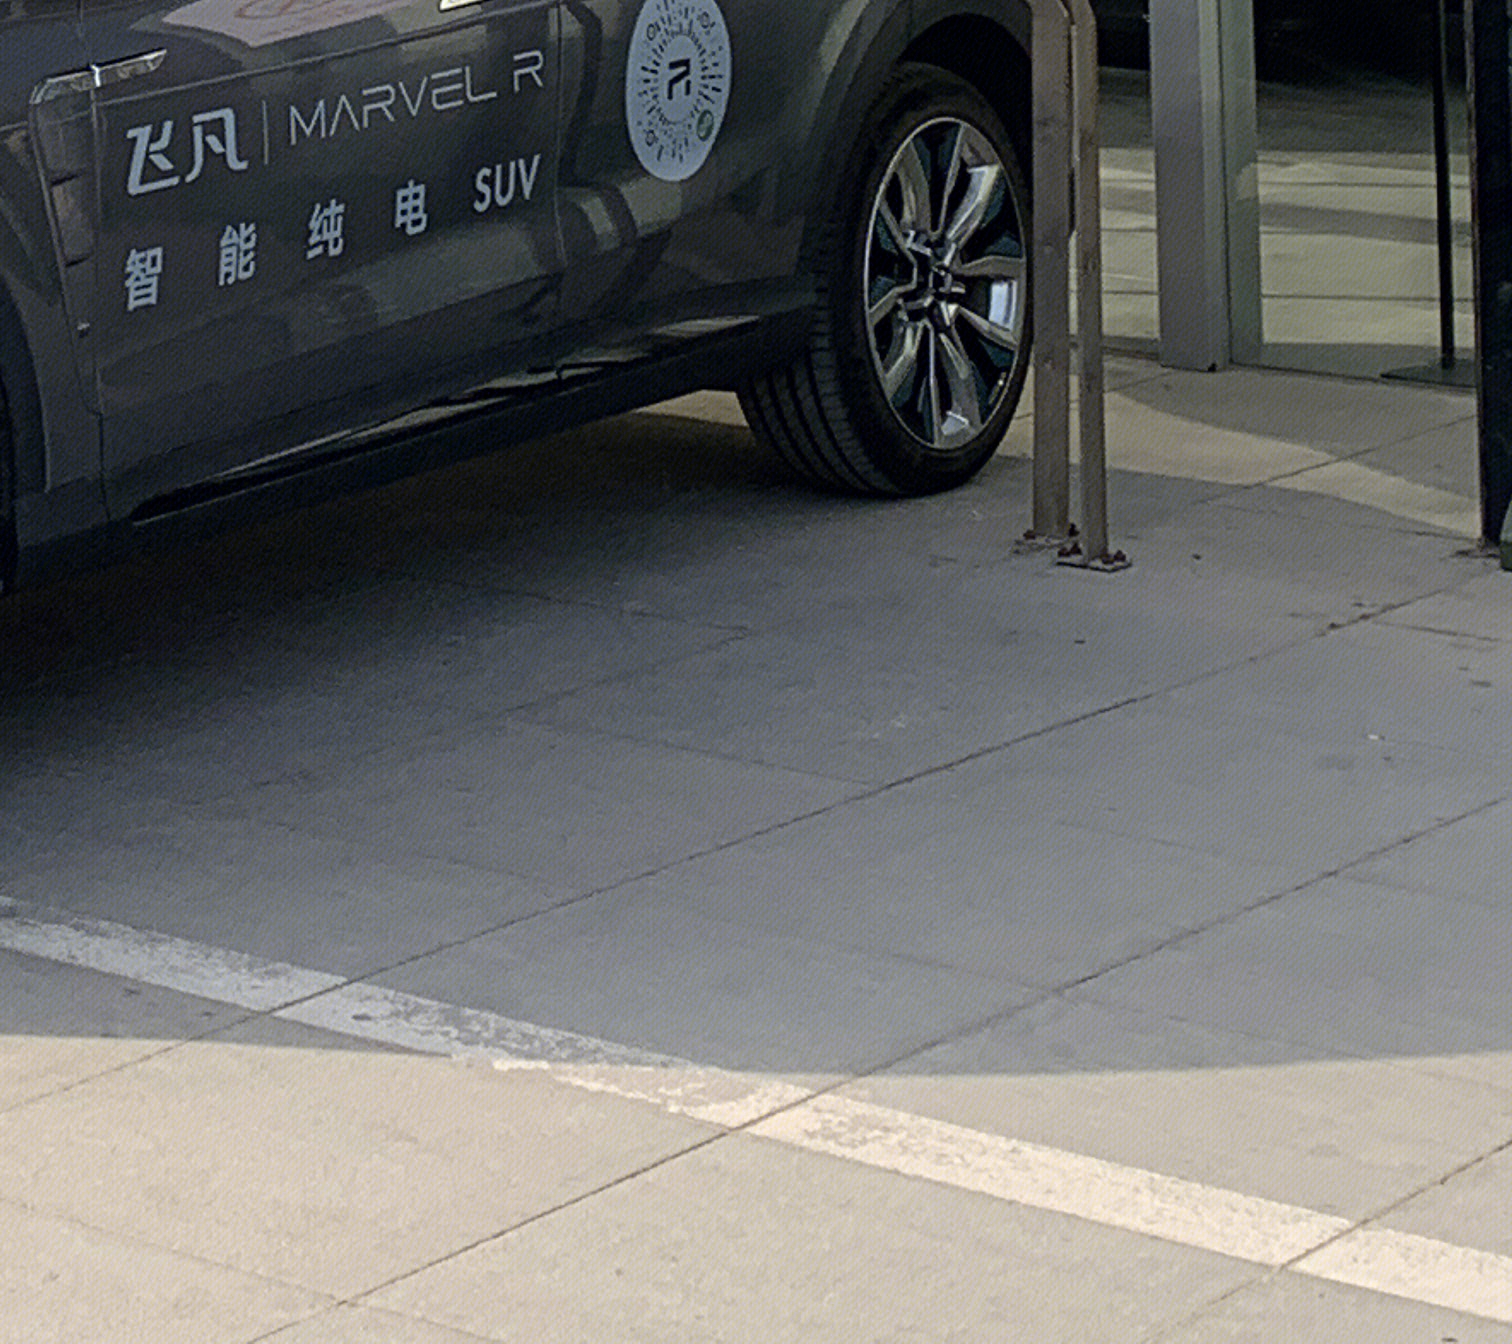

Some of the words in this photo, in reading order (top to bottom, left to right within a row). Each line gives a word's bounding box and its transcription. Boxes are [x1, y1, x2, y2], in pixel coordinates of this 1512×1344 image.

[126, 107, 248, 196] 飞凡
[290, 65, 498, 146] MARVEL
[513, 49, 545, 92] R
[473, 154, 541, 213] SUV
